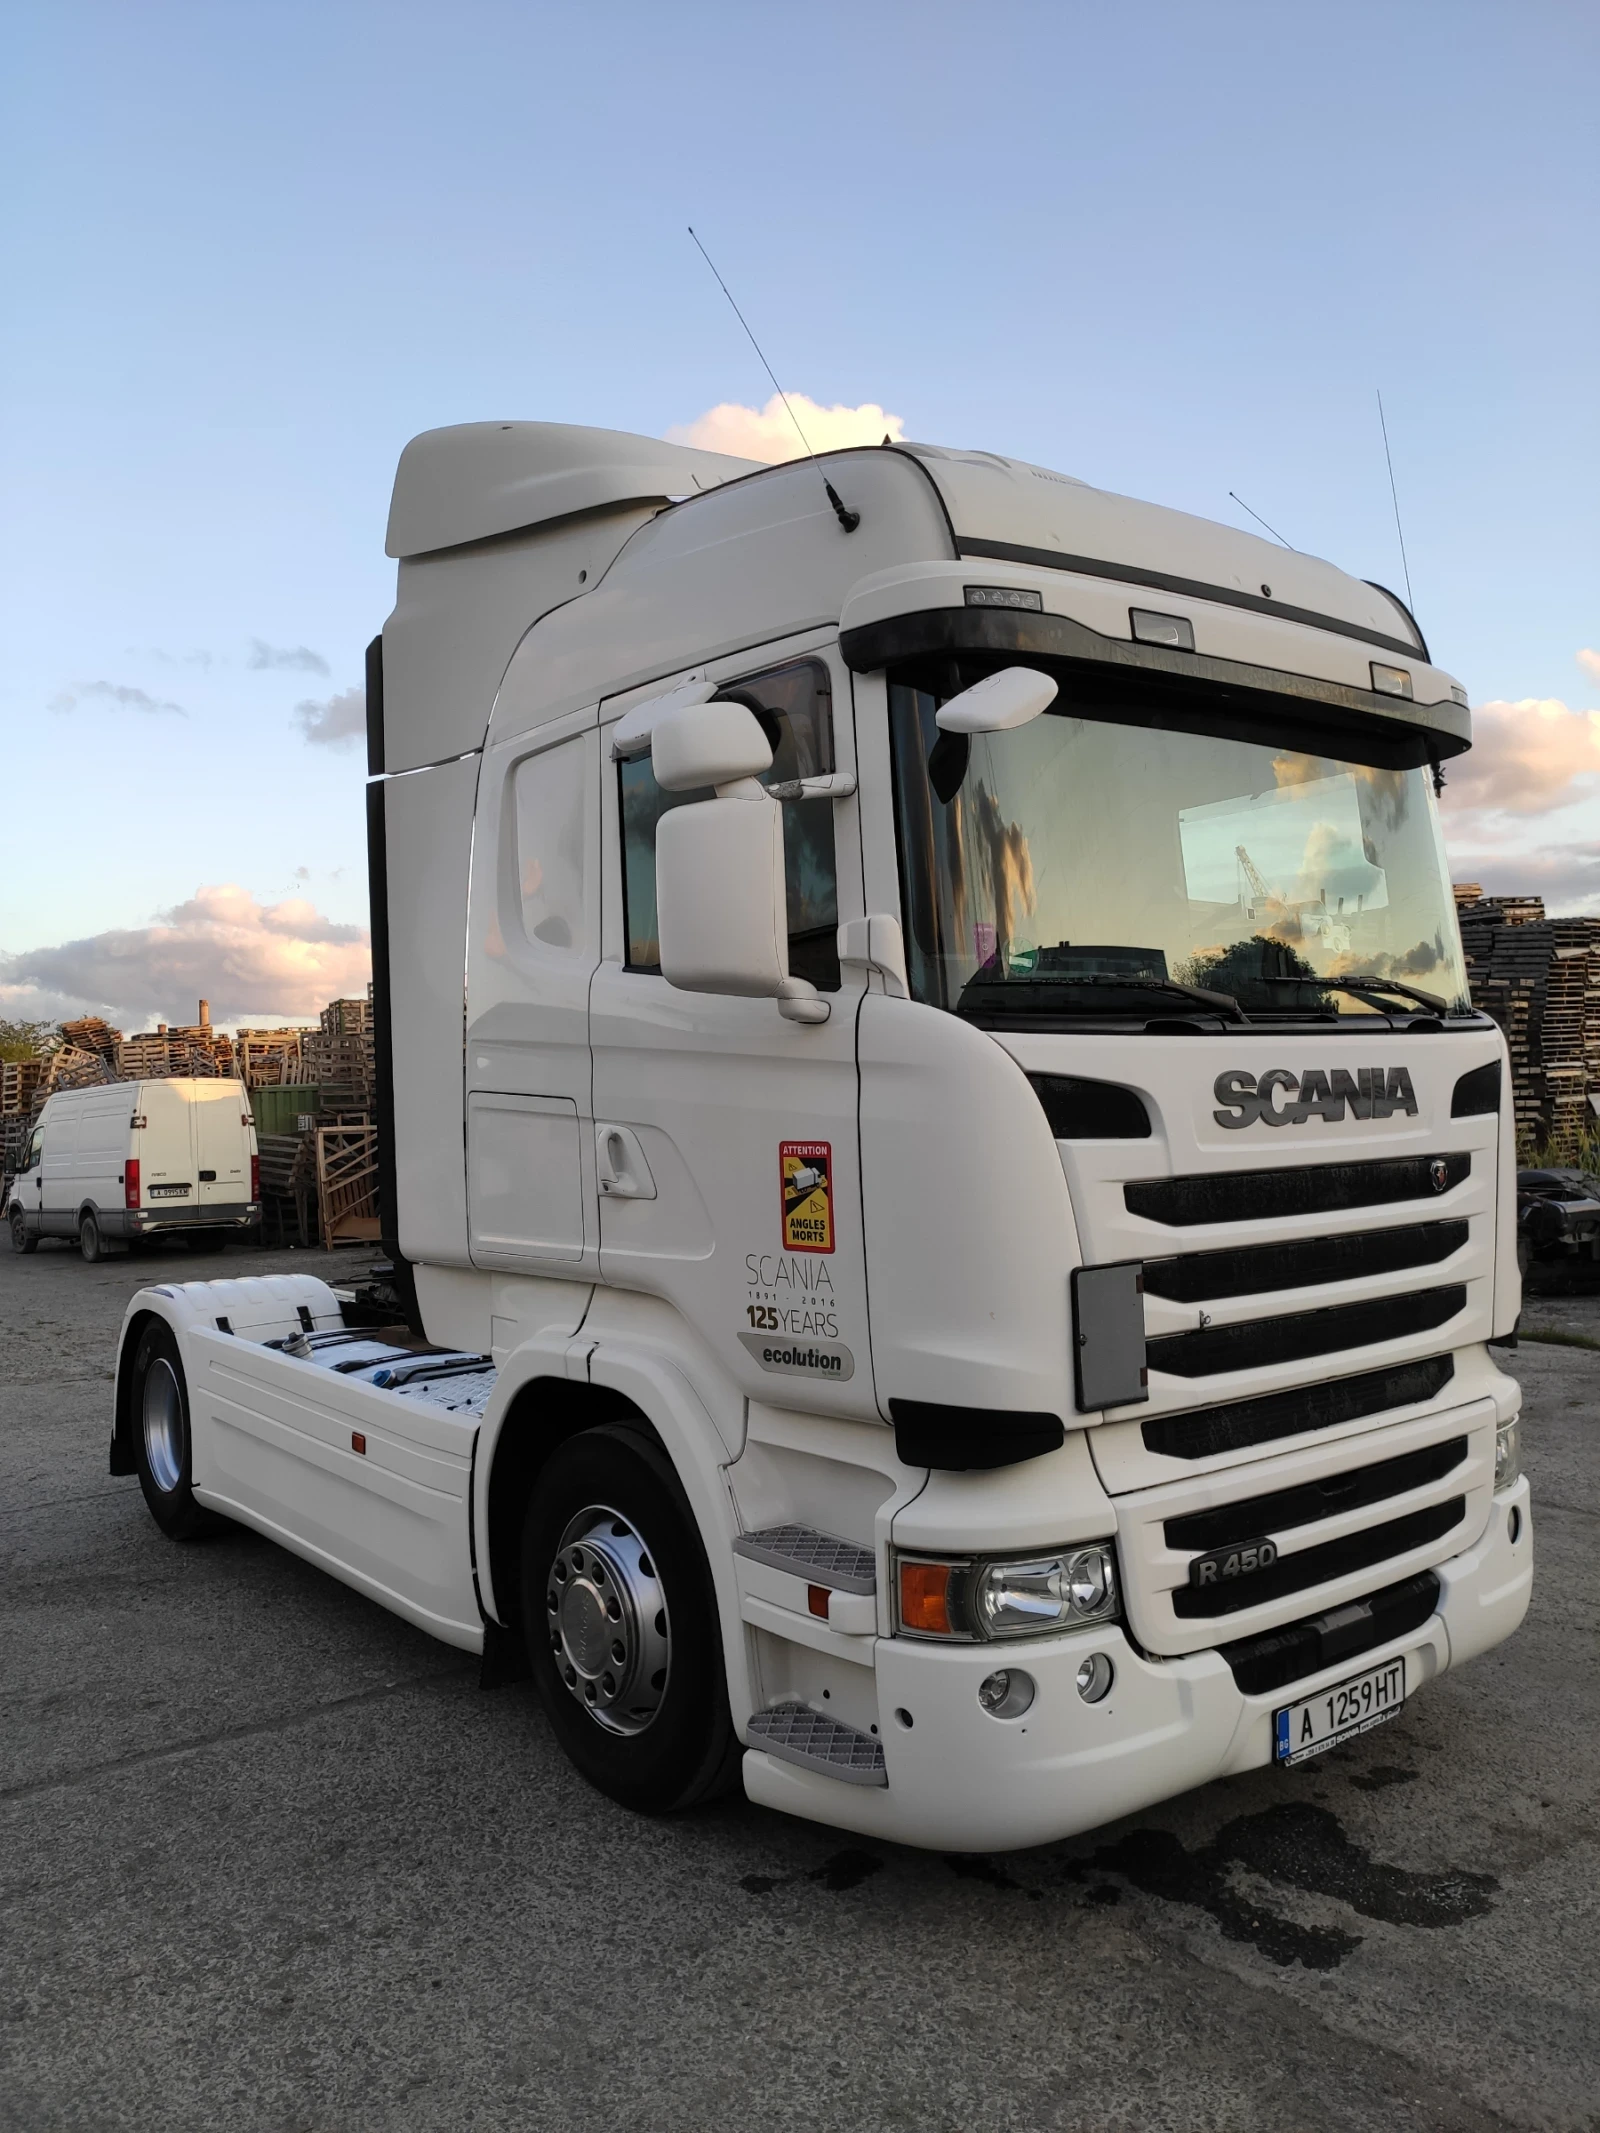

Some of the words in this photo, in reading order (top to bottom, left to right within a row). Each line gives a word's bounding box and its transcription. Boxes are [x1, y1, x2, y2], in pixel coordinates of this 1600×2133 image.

[1213, 1067, 1419, 1130] SCANIA
[782, 1145, 828, 1156] ATTENTION
[789, 1217, 826, 1231] ANGLES
[792, 1229, 825, 1242] MORTS
[745, 1253, 834, 1292] SCANIA
[748, 1291, 777, 1301] 1891
[802, 1296, 835, 1307] 2016
[763, 1347, 842, 1371] ecolution
[1199, 1560, 1218, 1585] R
[1222, 1544, 1275, 1577] 450
[1301, 1707, 1313, 1743] A
[1279, 1739, 1289, 1751] BG
